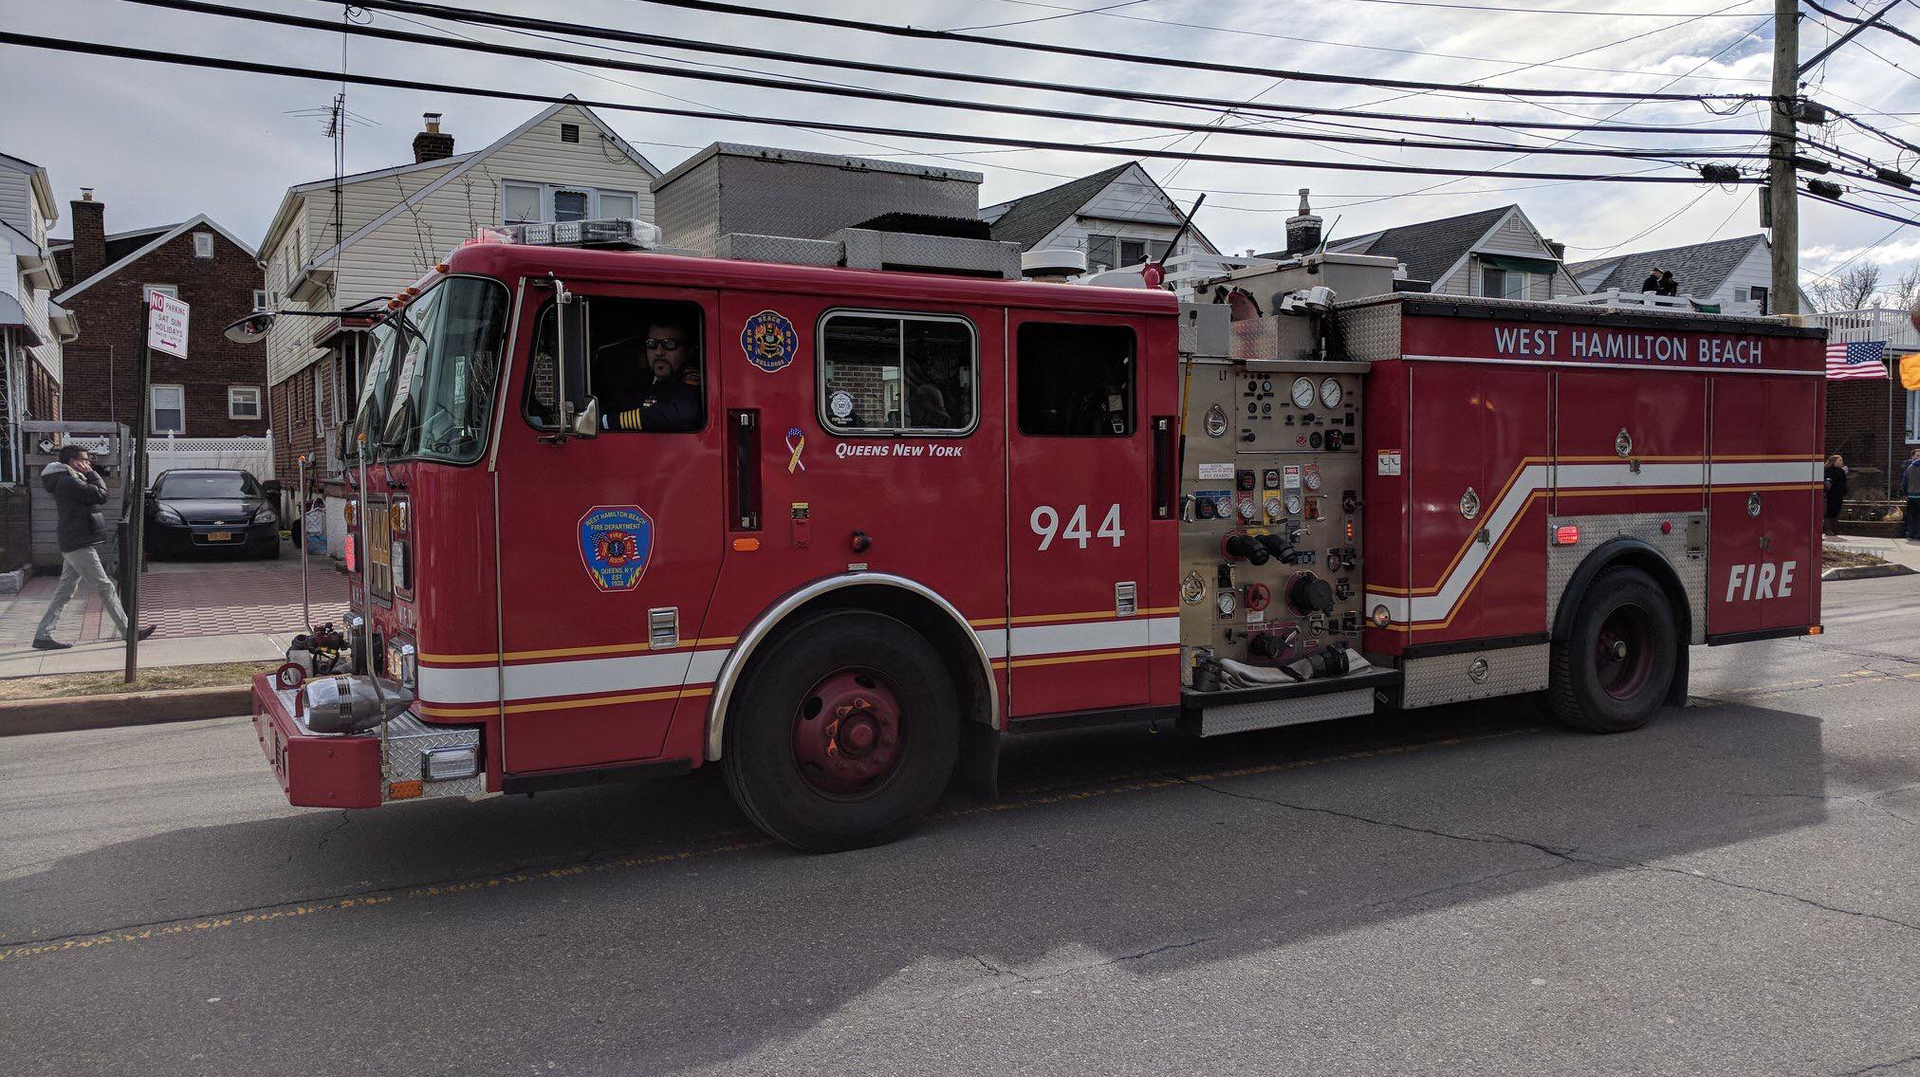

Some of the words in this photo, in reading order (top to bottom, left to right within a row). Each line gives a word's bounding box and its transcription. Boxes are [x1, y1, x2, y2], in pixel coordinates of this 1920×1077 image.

[152, 294, 163, 310] NO
[166, 303, 185, 316] PARKING
[158, 314, 169, 323] SAT
[171, 318, 182, 328] SUN
[757, 315, 781, 324] BEACH
[155, 322, 183, 338] HOLIDAYS
[1494, 327, 1558, 357] WEST
[1572, 331, 1687, 362] HAMILTON
[1699, 337, 1763, 366] BEACH
[835, 442, 889, 459] QUEENS
[893, 443, 924, 457] NEW
[928, 444, 963, 458] YORK
[585, 515, 600, 526] WEST
[600, 511, 628, 519] HAMILTON
[628, 512, 648, 525] BEACH
[1030, 503, 1125, 551] 944
[1726, 561, 1796, 603] FIRE
